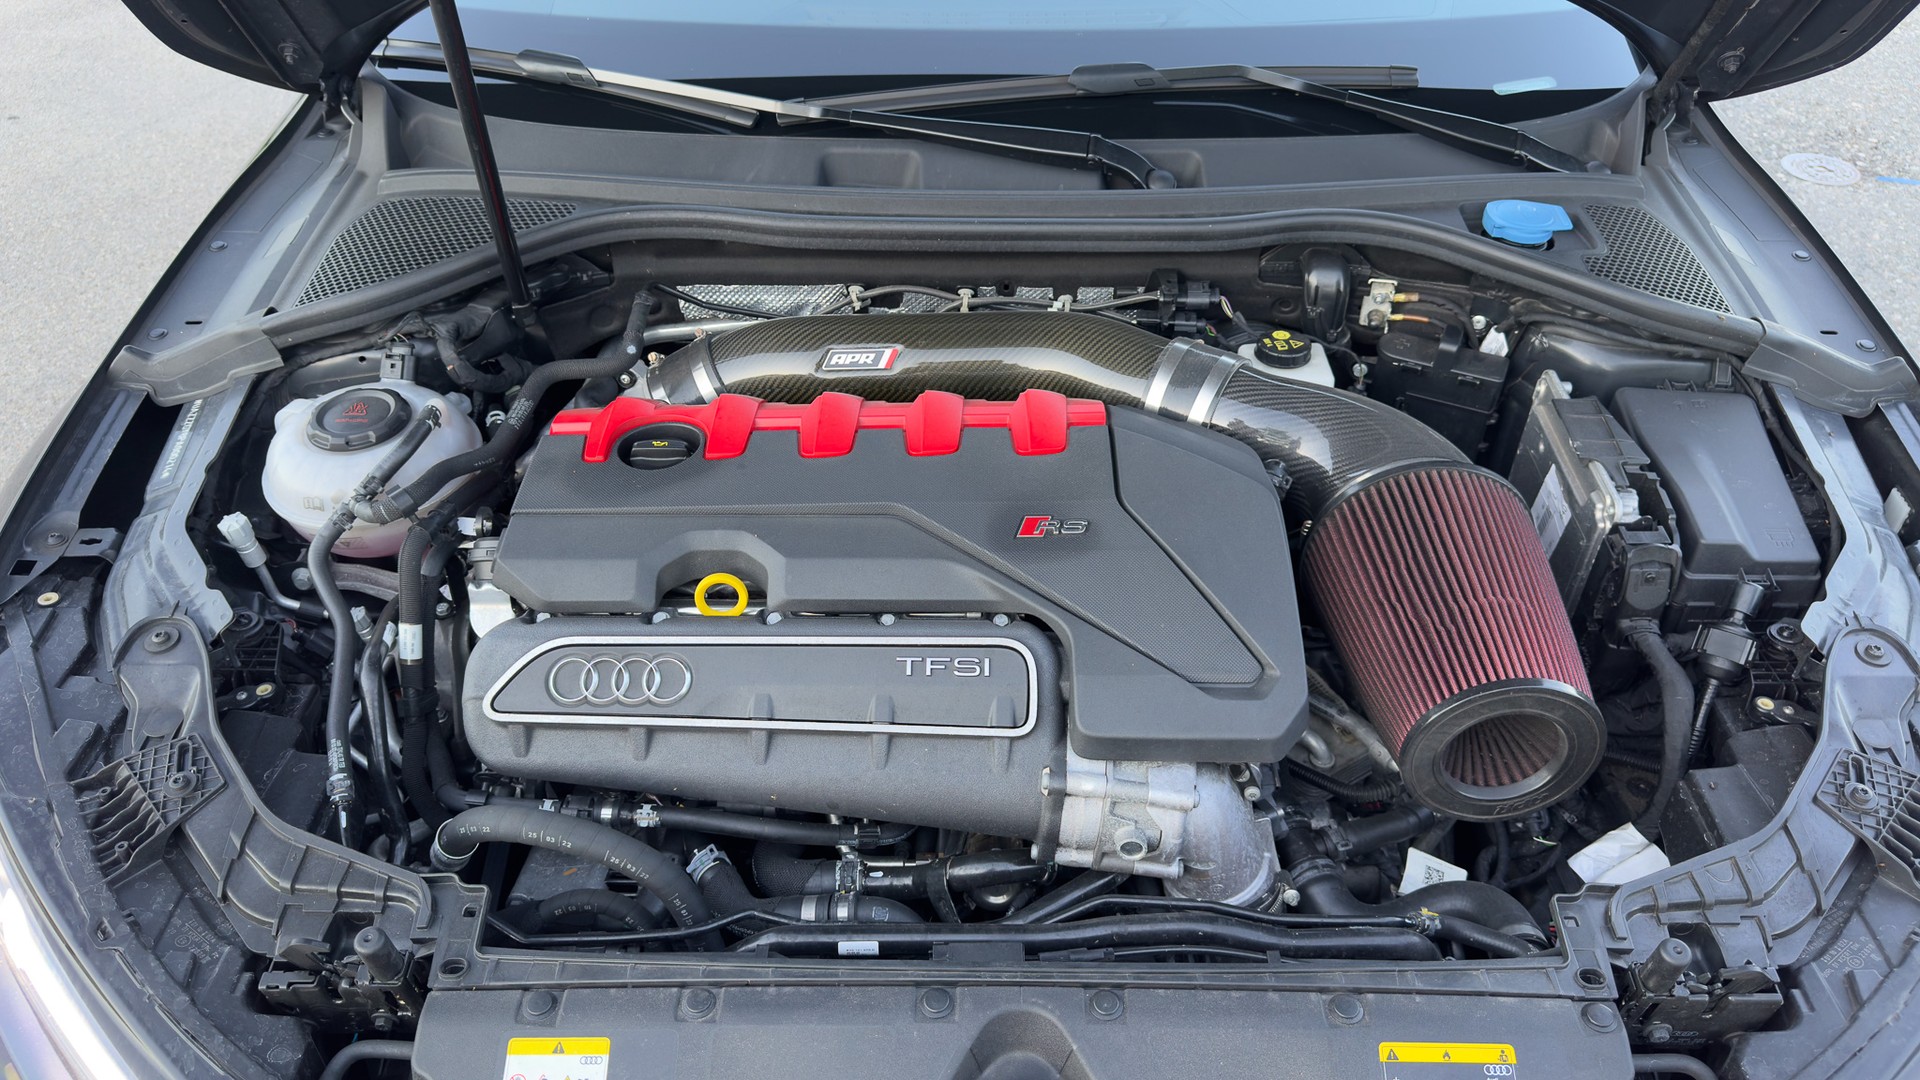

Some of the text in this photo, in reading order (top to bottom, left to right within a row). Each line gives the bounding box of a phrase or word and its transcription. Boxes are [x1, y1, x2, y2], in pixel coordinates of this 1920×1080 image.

[829, 352, 877, 366] APR
[1029, 519, 1089, 535] RS
[896, 657, 990, 677] TFSI
[527, 831, 572, 849] 25 03 22
[626, 863, 636, 872] 03
[639, 872, 650, 880] 22
